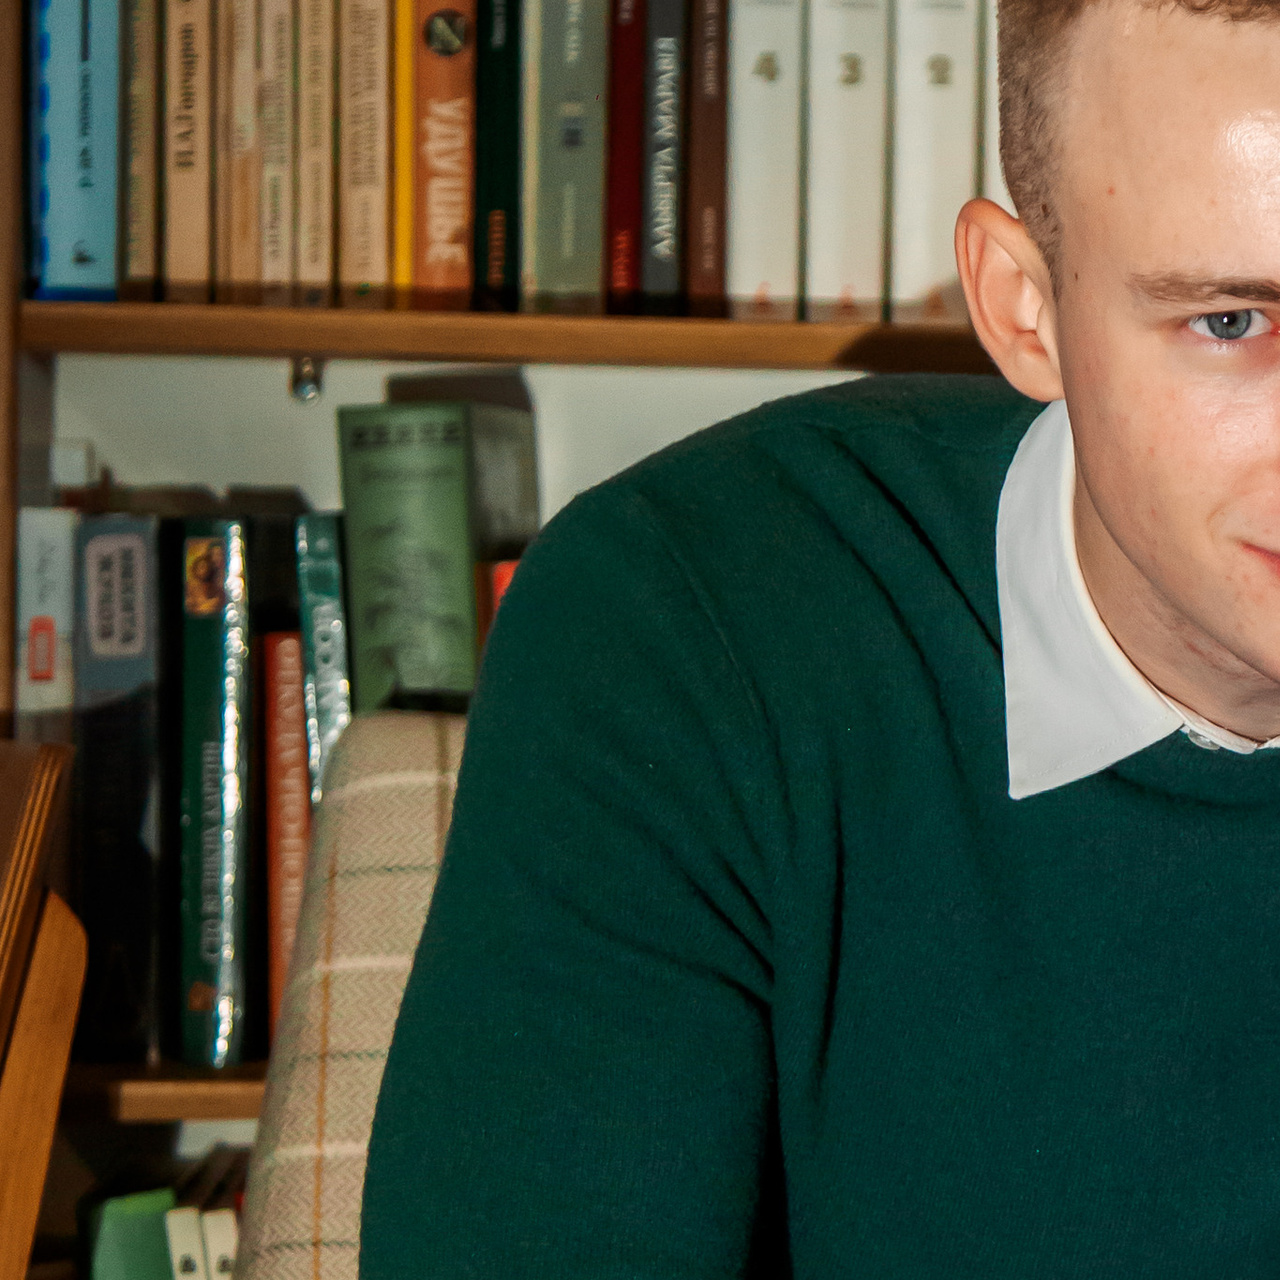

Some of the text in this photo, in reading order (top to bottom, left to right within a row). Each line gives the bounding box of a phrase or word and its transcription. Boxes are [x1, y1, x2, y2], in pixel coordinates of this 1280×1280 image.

[750, 52, 780, 83] 4
[838, 54, 863, 87] 3
[925, 54, 952, 86] 2
[422, 95, 468, 267] УДУШЬЕ
